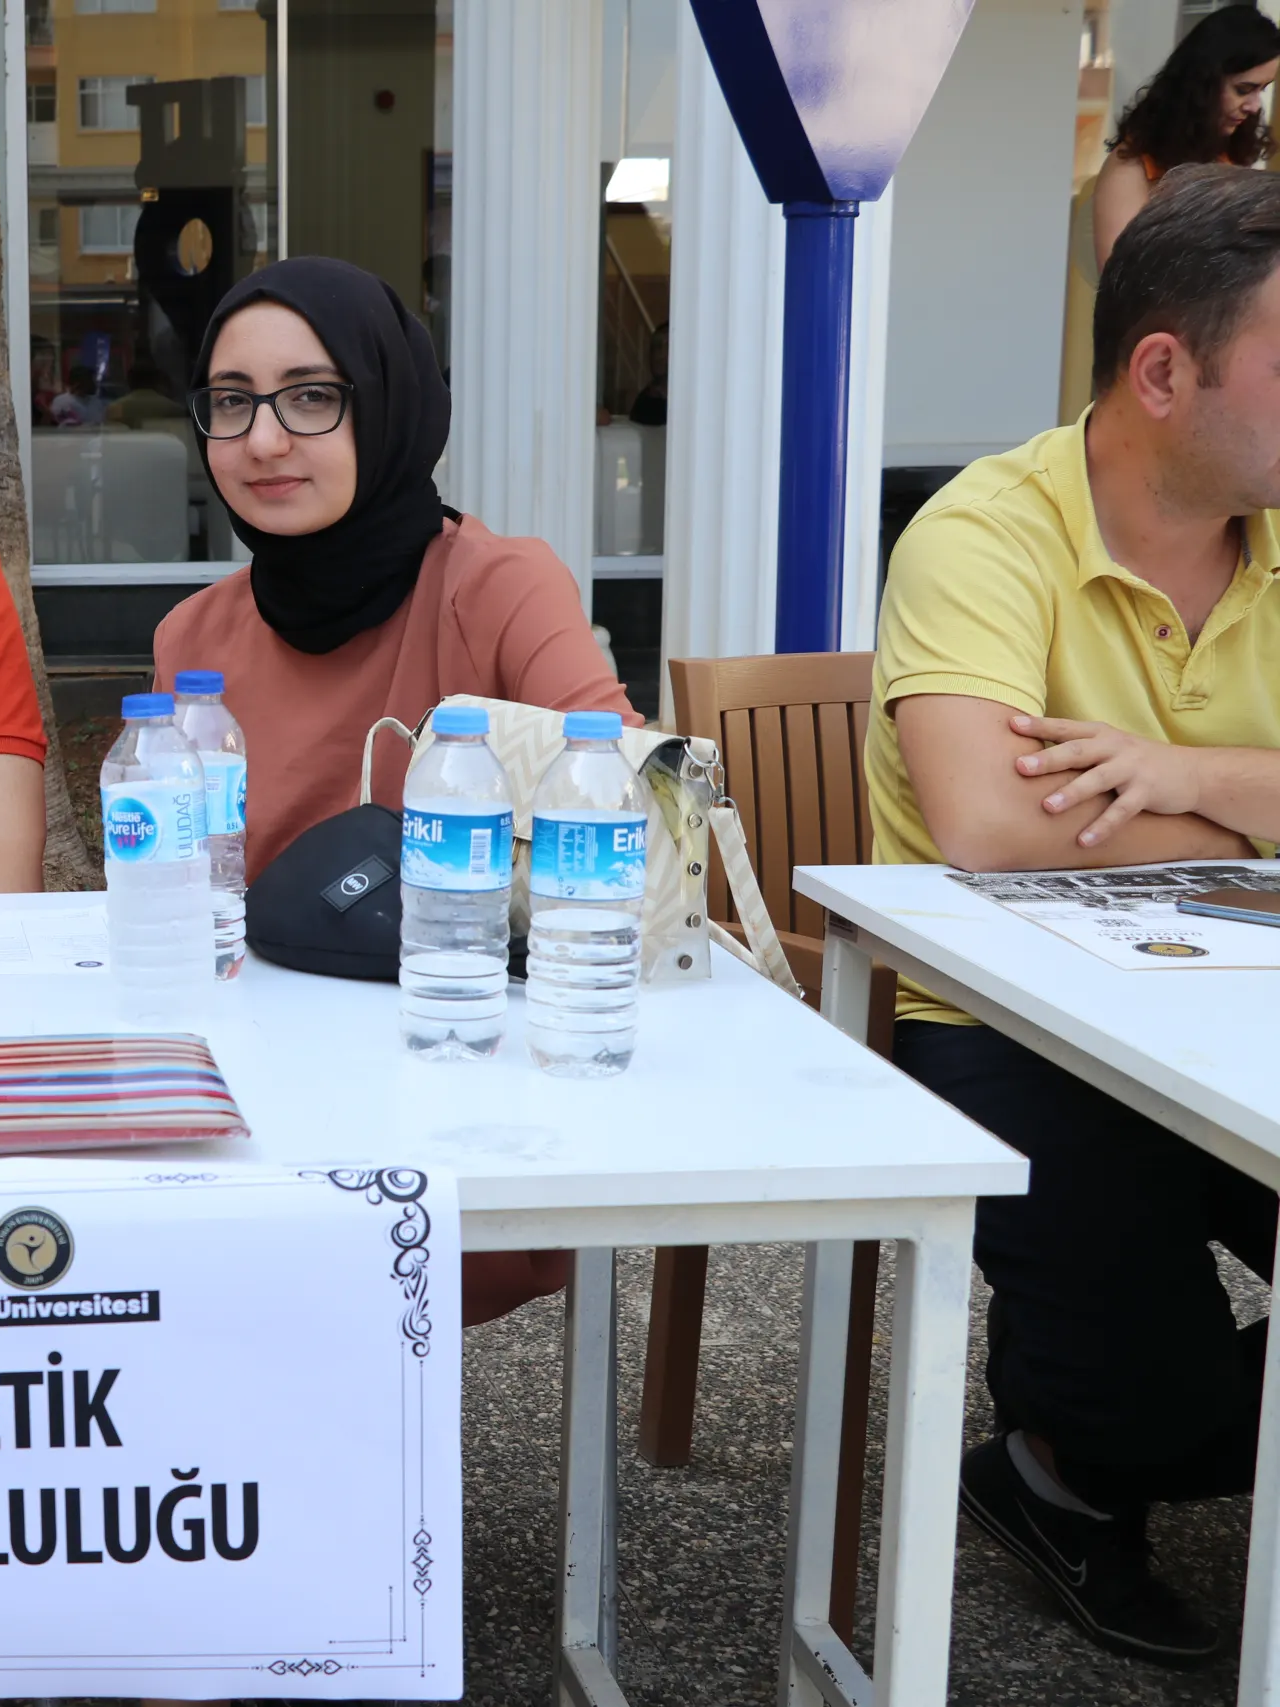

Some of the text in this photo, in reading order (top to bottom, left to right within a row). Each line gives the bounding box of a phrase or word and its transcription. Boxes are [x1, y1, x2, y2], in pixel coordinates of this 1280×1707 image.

[107, 822, 154, 840] Pure Life
[173, 793, 194, 859] ULUDAĞ
[403, 812, 443, 843] Erikli
[613, 826, 646, 852] Erik
